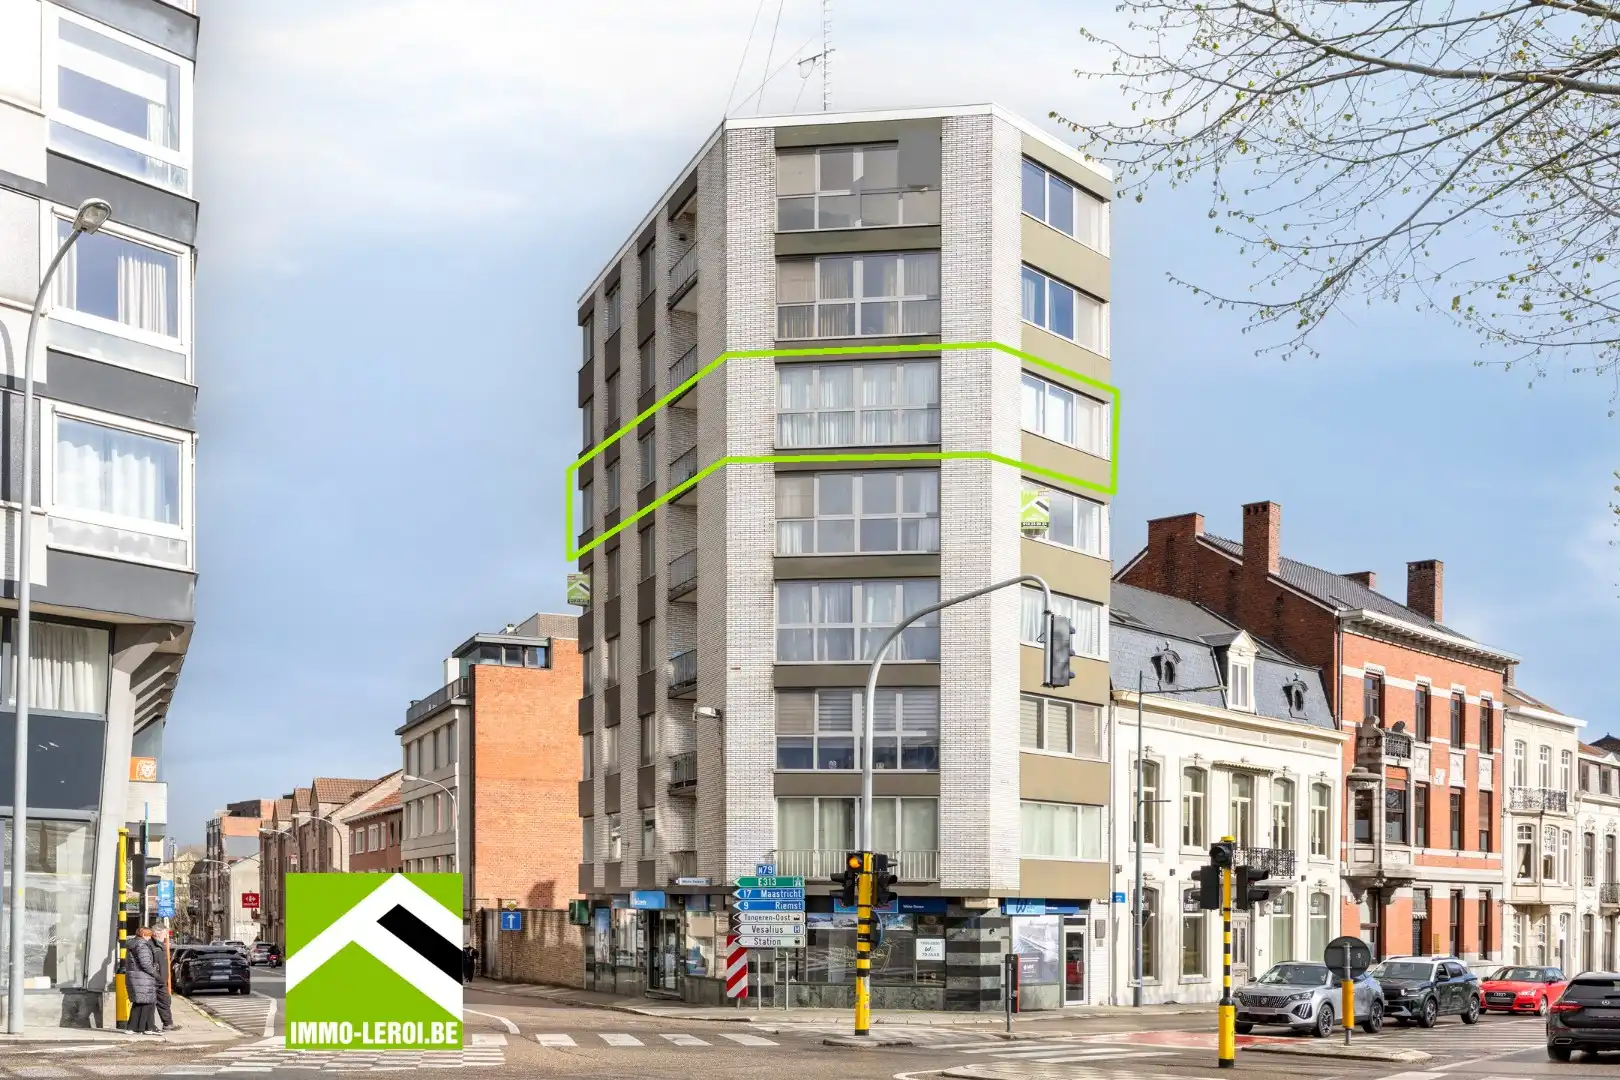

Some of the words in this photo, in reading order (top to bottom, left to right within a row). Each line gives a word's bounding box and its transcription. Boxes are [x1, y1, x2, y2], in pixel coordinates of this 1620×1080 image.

[758, 865, 773, 874] N79
[758, 877, 777, 886] E313
[743, 889, 752, 898] 17
[760, 889, 802, 898] Maastricht
[743, 901, 749, 910] 9
[775, 901, 802, 910] Riemst
[744, 913, 791, 922] Tongeren-Oost
[751, 925, 784, 934] Vesalius
[753, 937, 782, 946] Station
